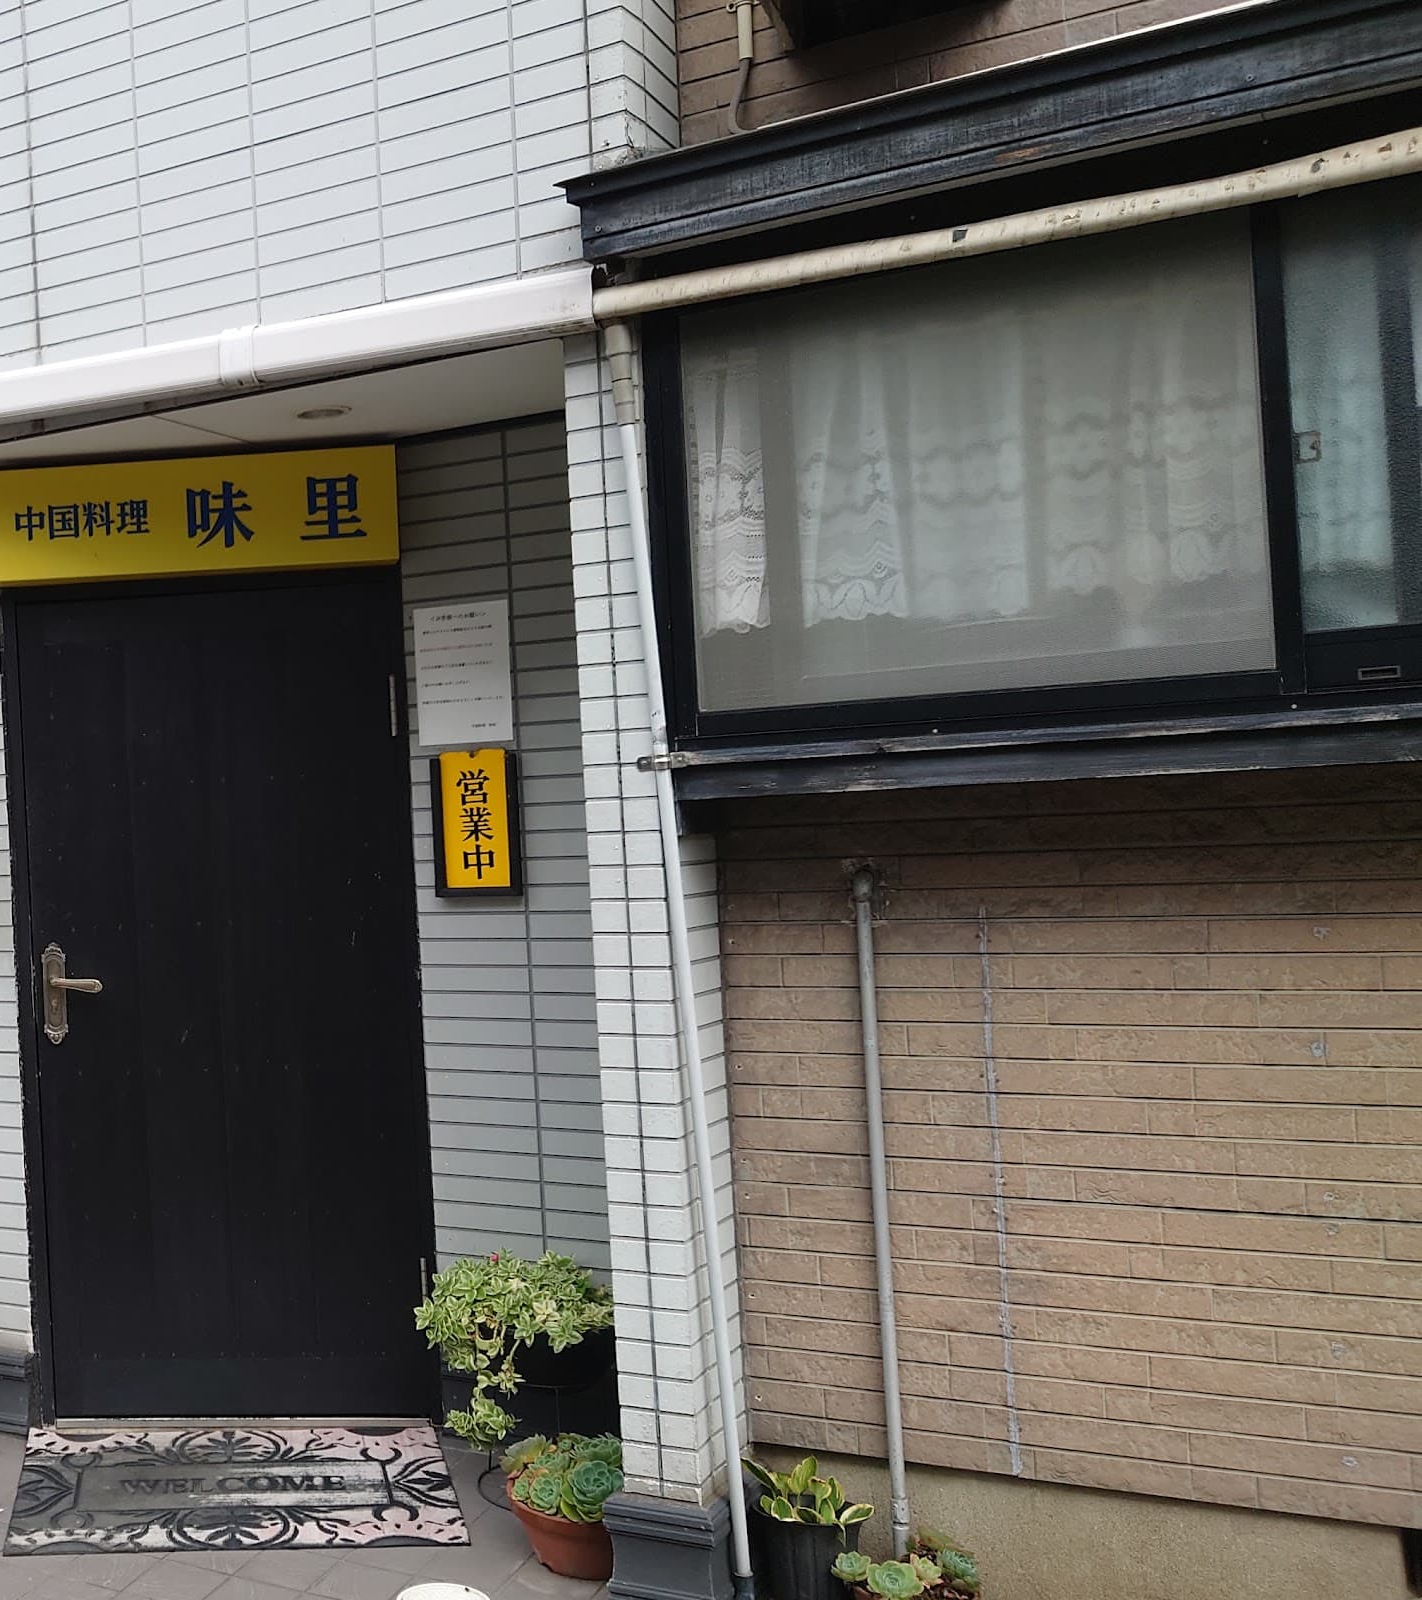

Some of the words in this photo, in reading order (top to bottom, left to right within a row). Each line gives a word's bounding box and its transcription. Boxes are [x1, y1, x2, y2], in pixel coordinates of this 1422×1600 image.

[14, 499, 151, 542] 中国料理
[456, 769, 495, 881] 営業中
[120, 1474, 347, 1496] WELCOME
